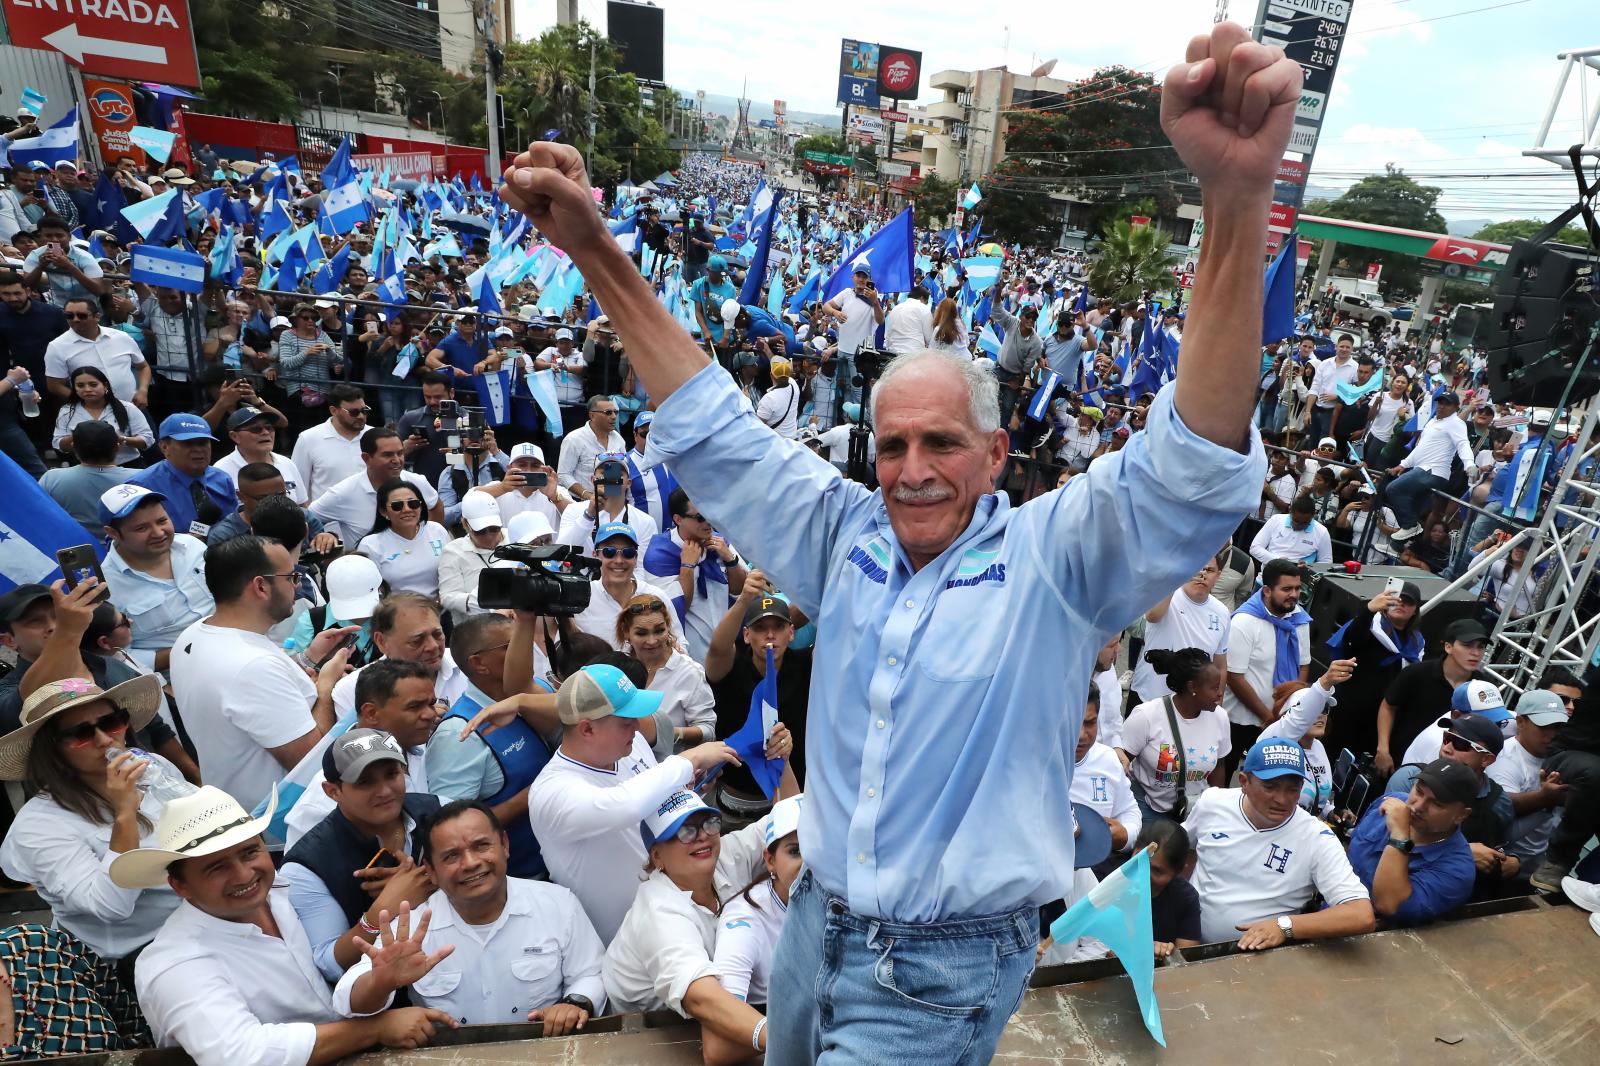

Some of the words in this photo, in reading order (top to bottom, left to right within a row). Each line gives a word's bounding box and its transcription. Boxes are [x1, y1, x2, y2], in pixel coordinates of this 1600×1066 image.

[12, 0, 179, 28] TRADA
[887, 67, 909, 78] Pizza
[890, 76, 907, 84] Hut
[414, 154, 432, 173] CHINA
[762, 598, 773, 610] P
[1262, 744, 1300, 755] CARLOS
[1264, 753, 1300, 762] LEDEZMA
[1264, 759, 1301, 768] DIPUTADO
[1091, 777, 1108, 801] H
[1264, 843, 1293, 874] H
